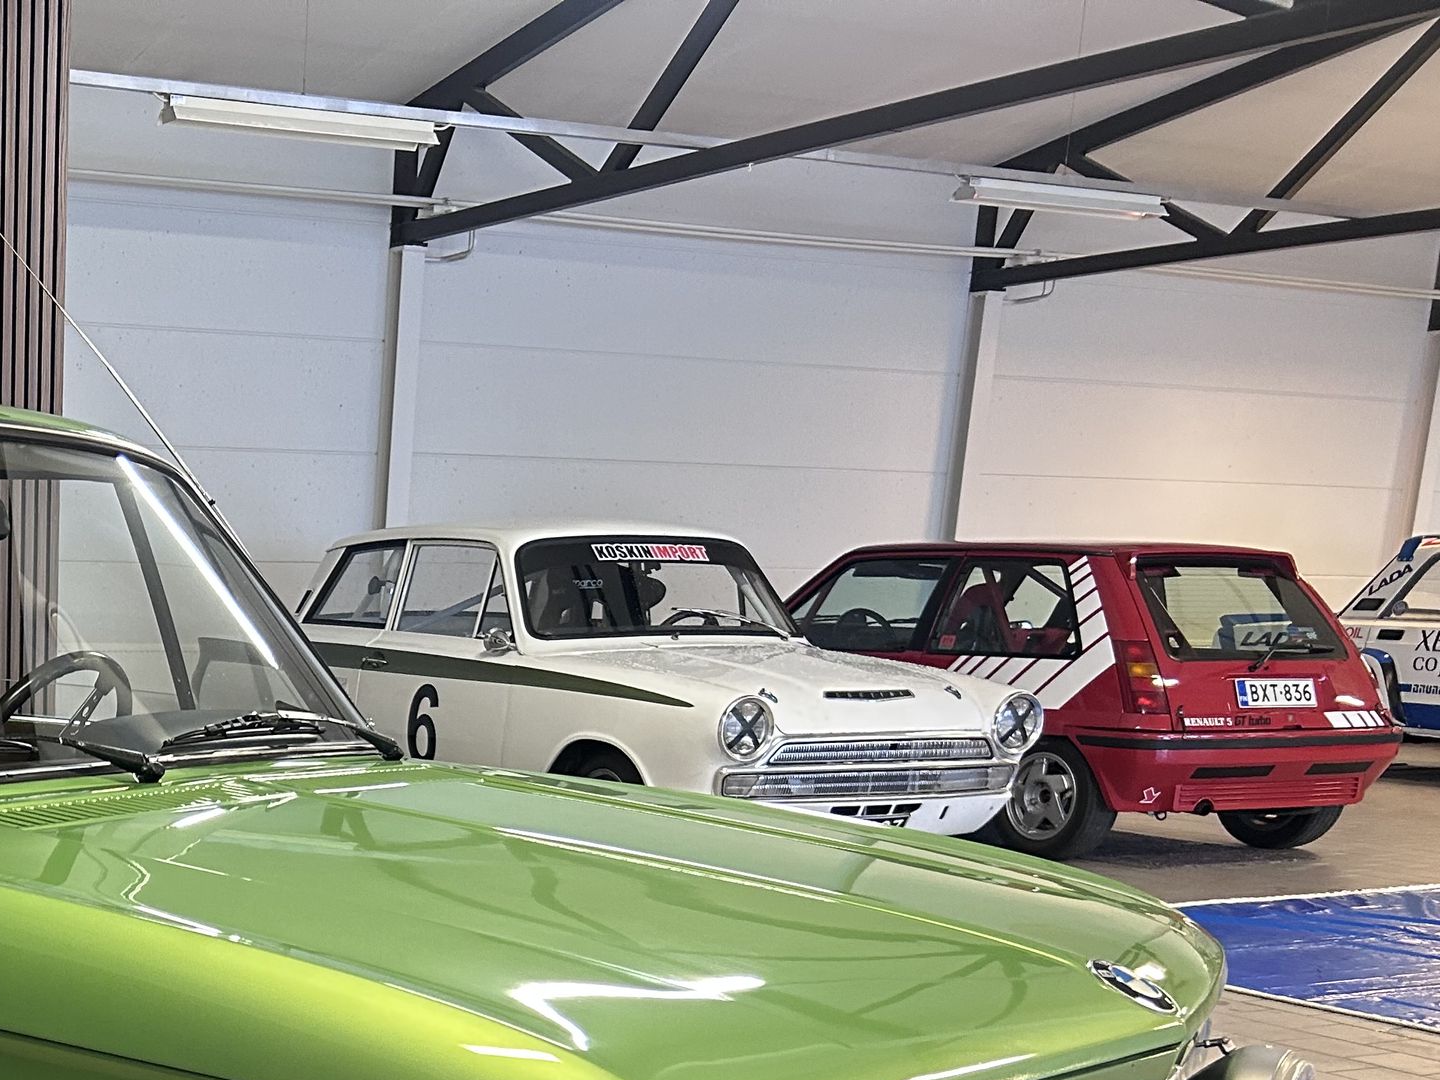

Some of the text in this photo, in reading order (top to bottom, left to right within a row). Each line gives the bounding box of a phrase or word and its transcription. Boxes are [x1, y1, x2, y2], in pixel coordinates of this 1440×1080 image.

[592, 544, 708, 560] KOSKINIMPORT
[1368, 563, 1414, 596] LADA
[407, 683, 440, 760] 6
[1183, 717, 1225, 727] RENAULT
[1226, 717, 1233, 727] 5
